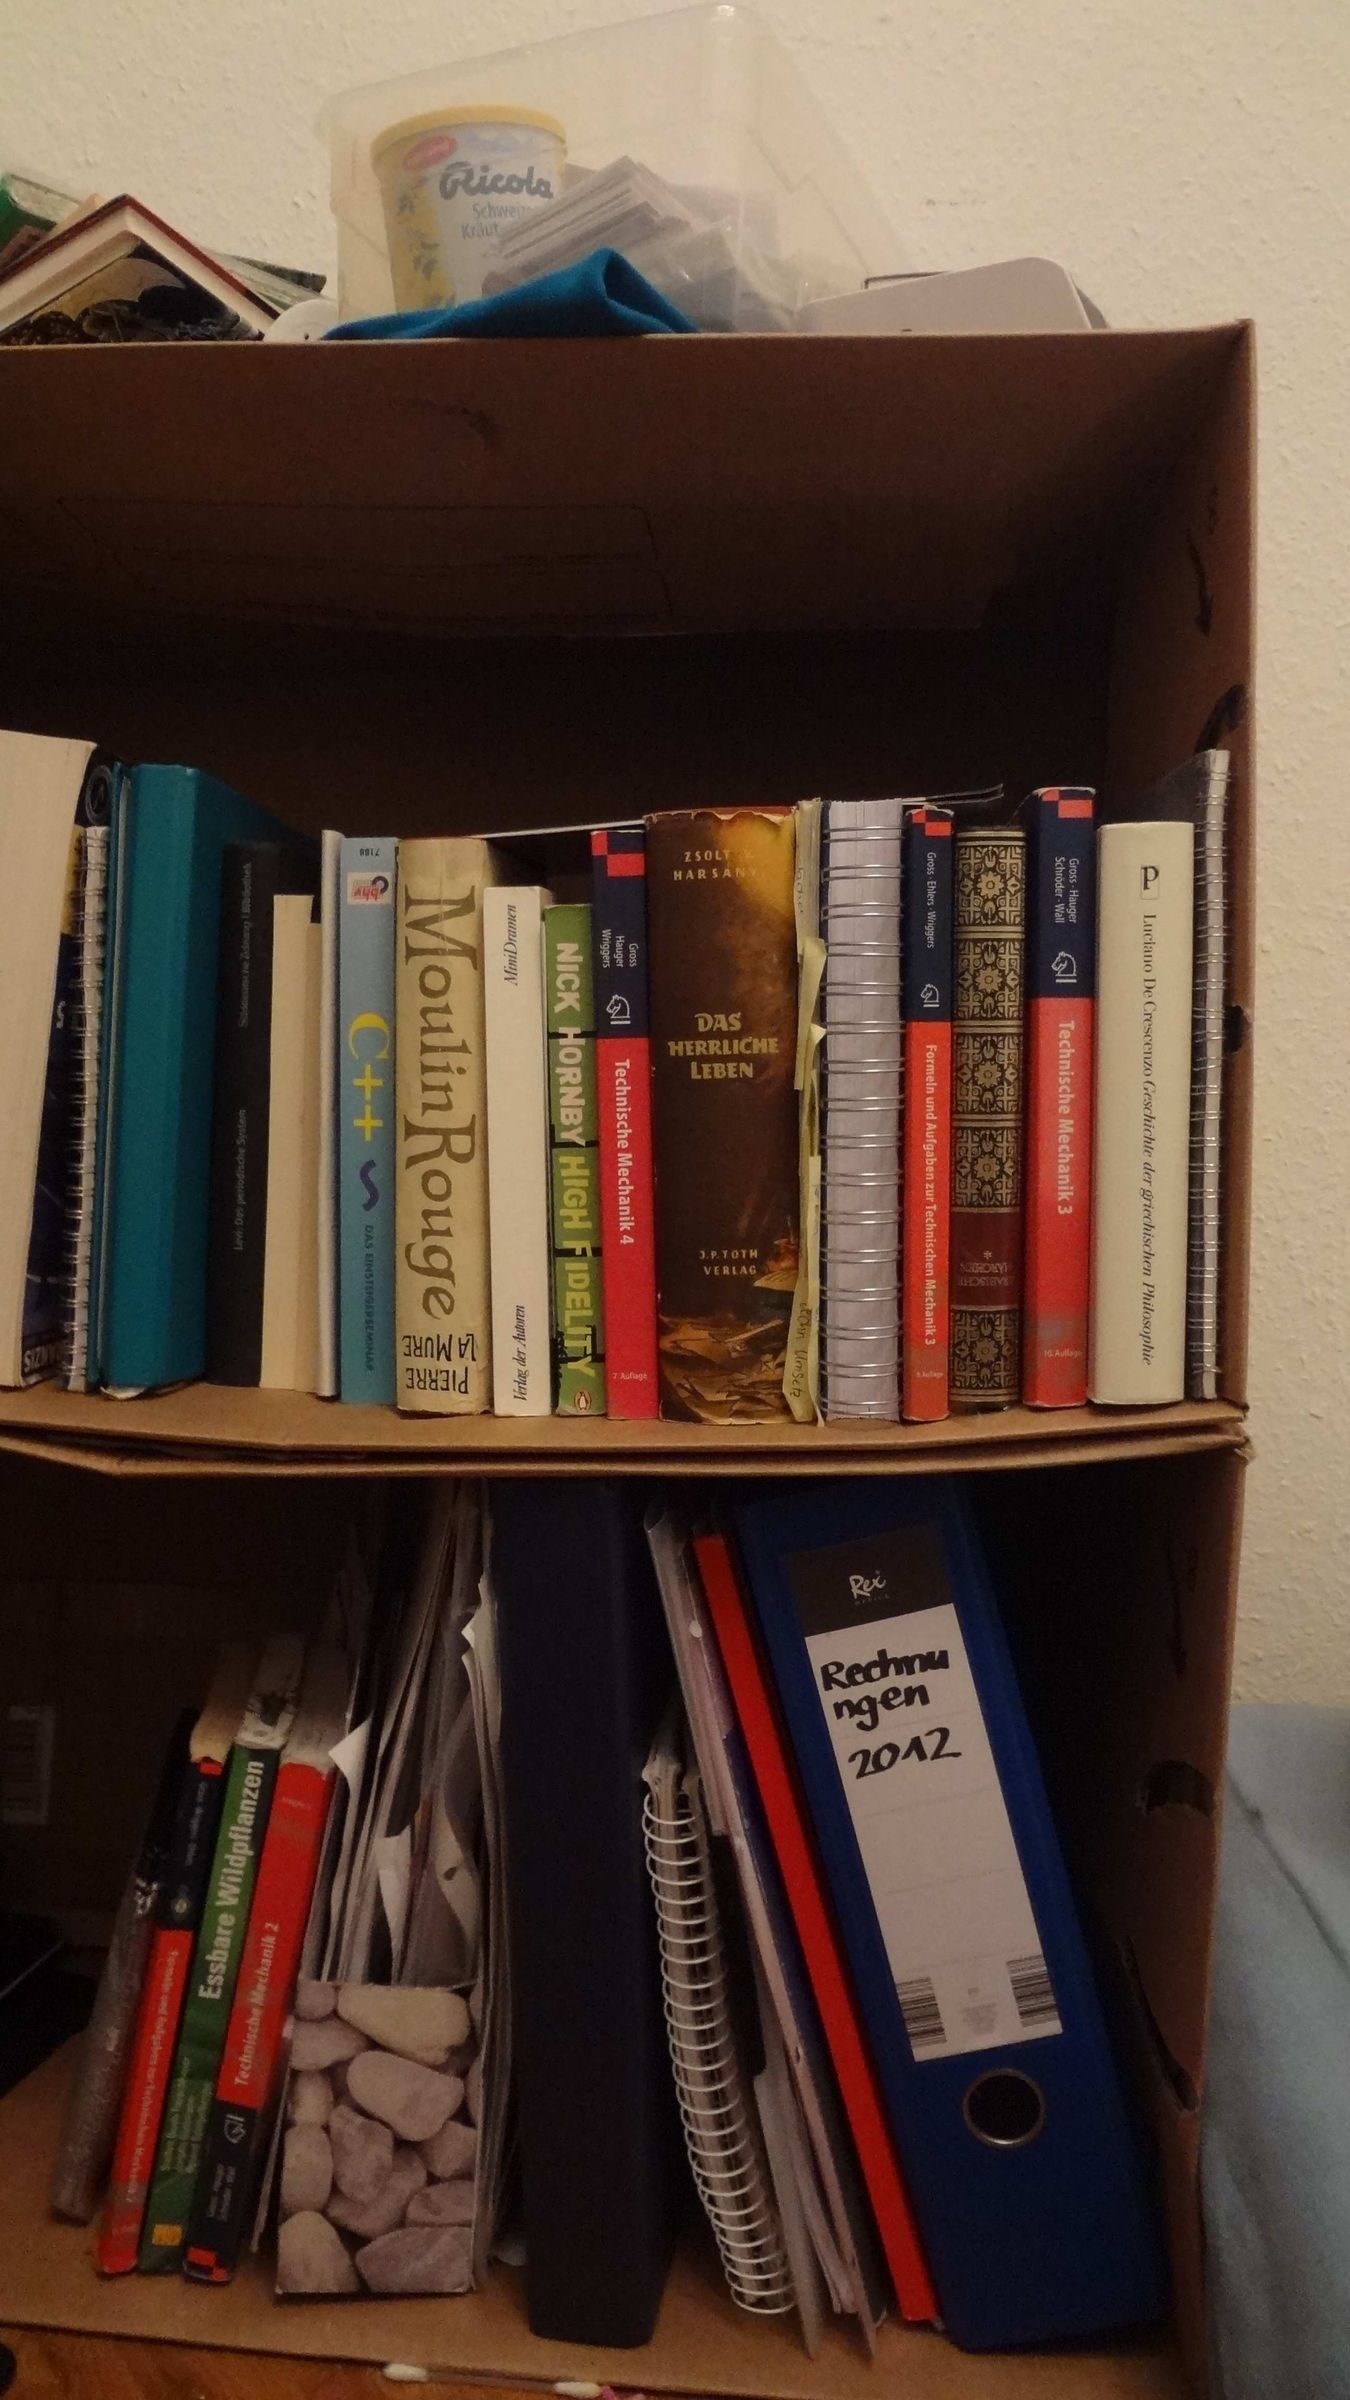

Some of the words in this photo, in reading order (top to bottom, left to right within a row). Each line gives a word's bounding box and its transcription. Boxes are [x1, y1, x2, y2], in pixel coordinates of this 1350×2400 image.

[439, 160, 554, 200] Ricola
[683, 849, 730, 863] ZSOLT
[926, 851, 937, 876] Gross
[1069, 858, 1080, 884] Gross
[926, 880, 937, 906] Ehlers
[1054, 856, 1066, 898] Schröder
[1054, 903, 1066, 924] Wall
[1066, 889, 1080, 924] Hauger
[602, 928, 612, 969] Wriggers
[924, 911, 937, 949] Wriggers
[1142, 914, 1157, 973] Luciano
[615, 935, 625, 968] Hauger
[629, 943, 639, 968] Gross
[554, 942, 584, 1014] NICK
[1142, 978, 1157, 998] De
[694, 1011, 743, 1033] DAS
[1142, 1001, 1157, 1077] Crescenzo
[667, 1036, 779, 1058] HERRLICHE
[1058, 1020, 1075, 1114] Technische
[348, 1012, 390, 1142] C++
[556, 1027, 586, 1148] HORNBY
[690, 1060, 755, 1081] LEBEN
[925, 1044, 937, 1094] Formeln
[615, 1059, 632, 1150] Technische
[925, 1096, 937, 1120] und
[1142, 1079, 1157, 1157] Geschichte
[922, 1122, 937, 1181] Aufgaben
[1057, 1118, 1075, 1202] Mechanik
[559, 1156, 593, 1229] HIGH
[617, 1152, 636, 1232] Mechanik
[924, 1182, 935, 1203] zur
[1142, 1160, 1156, 1188] der
[1057, 1204, 1073, 1216] 3
[364, 1224, 375, 1249] DAS
[619, 1234, 635, 1246] 4
[924, 1203, 937, 1277] Technischen
[1139, 1187, 1156, 1277] griechischen
[703, 1264, 758, 1276] VERLAG
[512, 1305, 527, 1348] Autoren
[563, 1240, 595, 1378] FIDELITY
[924, 1279, 937, 1337] Mechanik
[1139, 1282, 1155, 1366] Philosophie
[402, 1334, 453, 1361] MURE
[512, 1347, 527, 1367] der
[924, 1337, 936, 1345] 3
[406, 1366, 469, 1394] PIERRE
[513, 1369, 529, 1401] Verlag
[849, 1569, 886, 1599] Rex
[833, 1684, 931, 1732] ngen
[848, 1727, 963, 1780] 2012
[216, 1760, 265, 1907] Wildpflanzen
[198, 1912, 236, 2000] Essbare
[233, 2006, 264, 2087] Technische
[249, 1933, 277, 2007] Mechanik
[264, 1921, 280, 1933] 2
